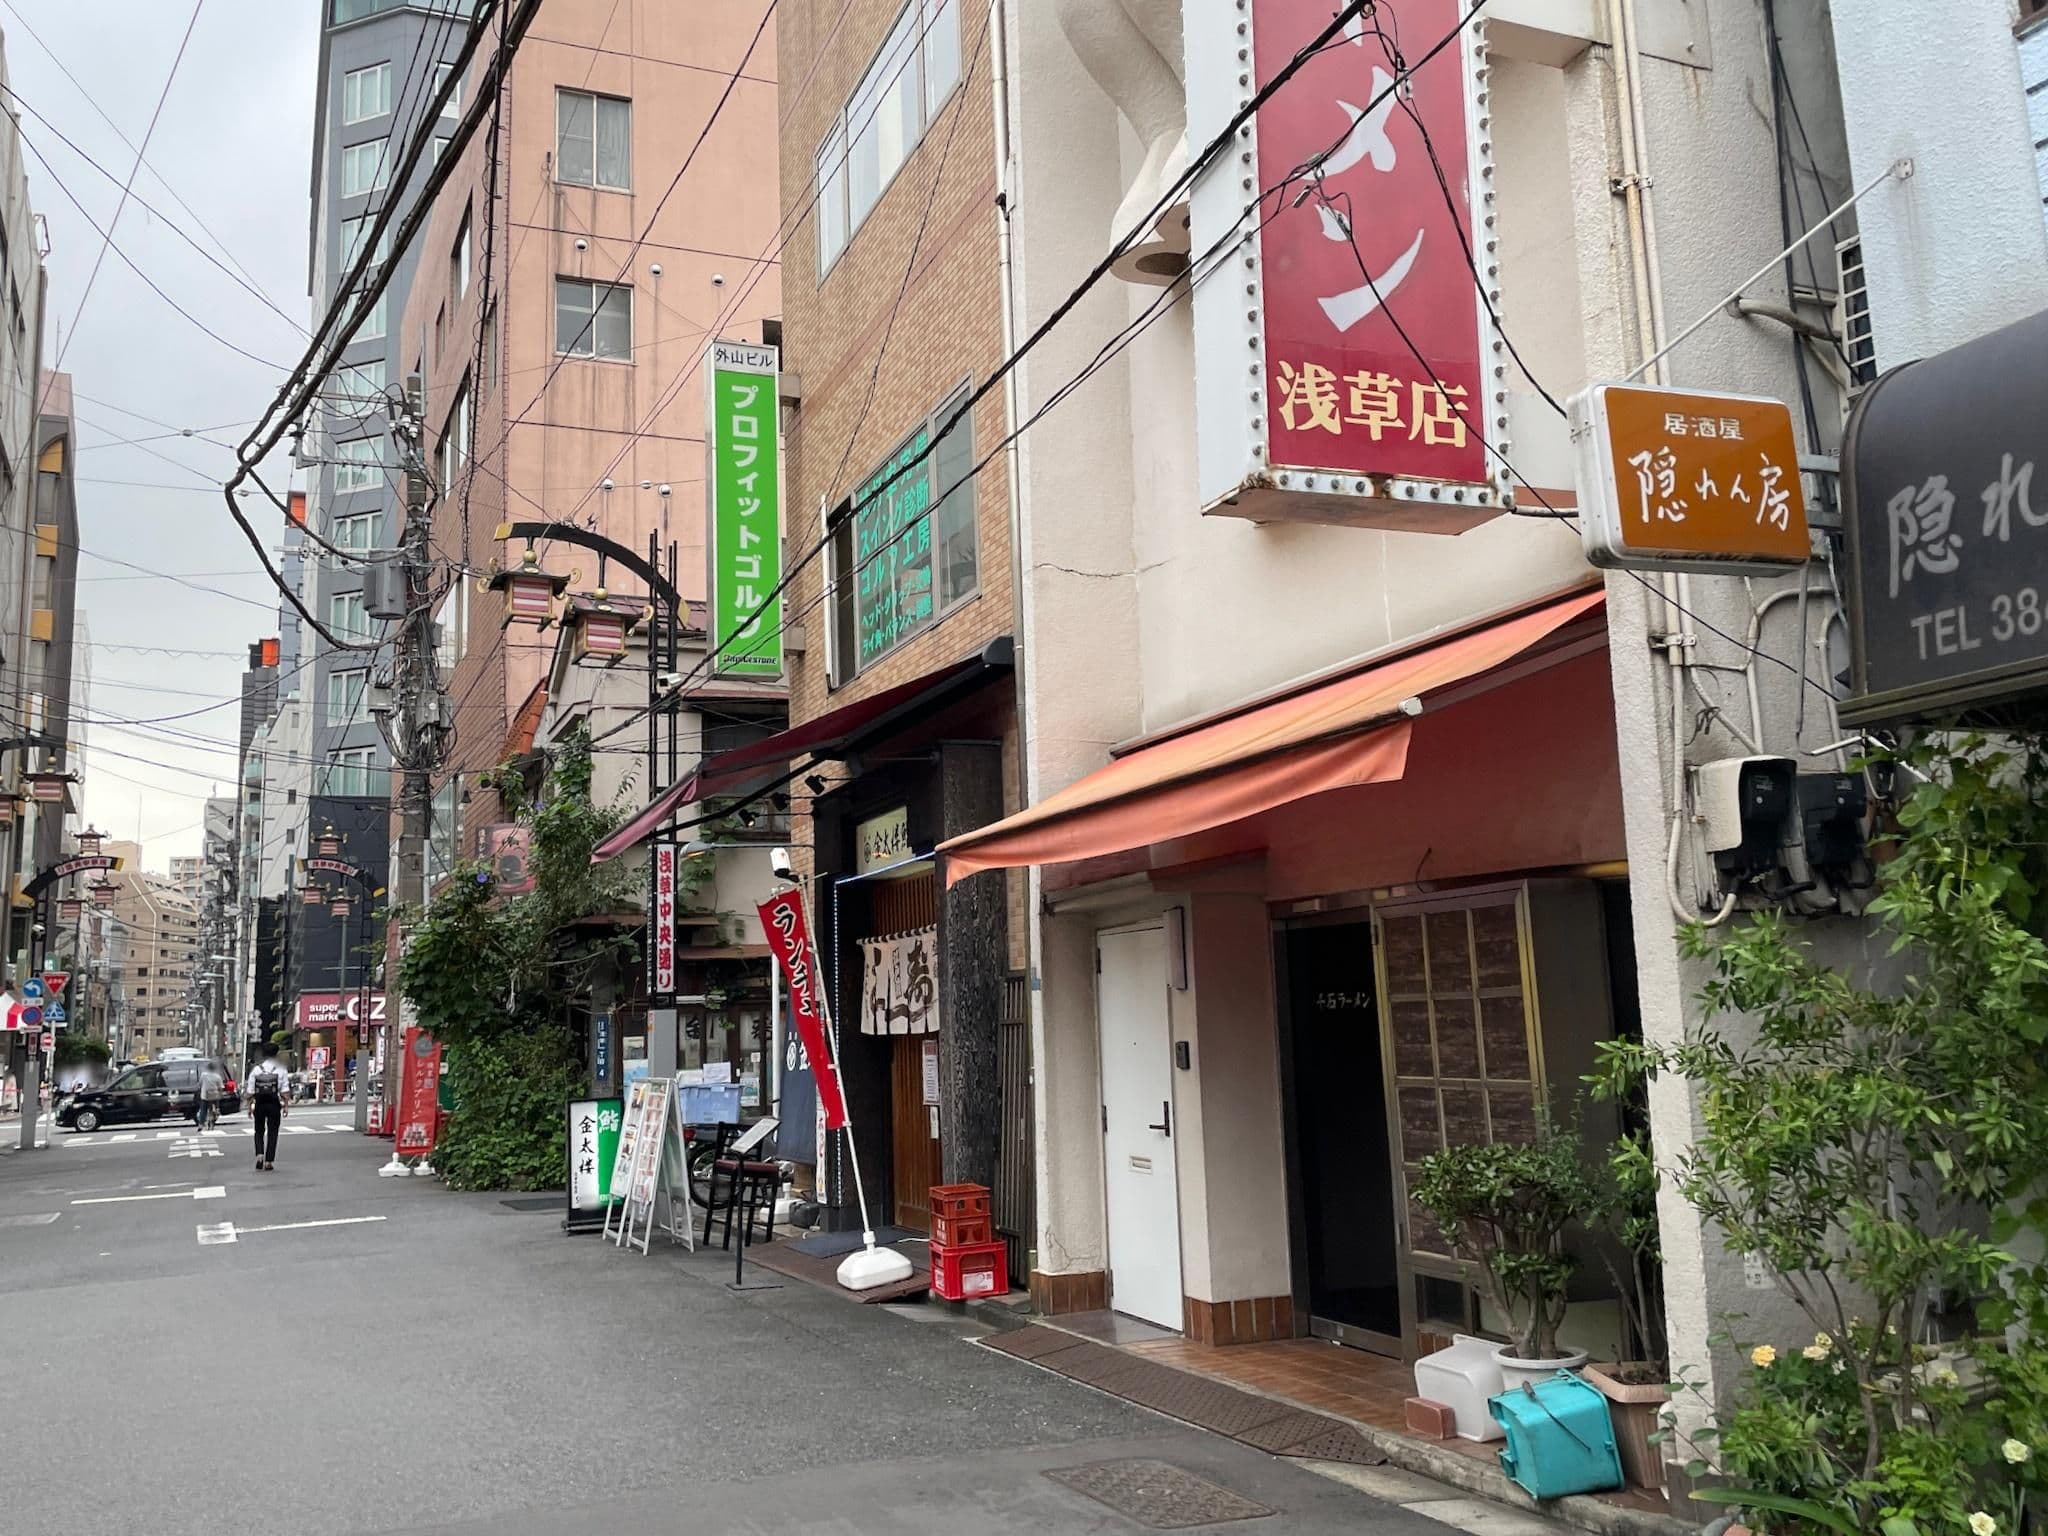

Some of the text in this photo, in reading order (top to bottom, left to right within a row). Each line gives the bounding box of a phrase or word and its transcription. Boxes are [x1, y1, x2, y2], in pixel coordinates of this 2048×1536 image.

[715, 347, 773, 368] 外山ビル
[1276, 360, 1469, 449] 浅草店
[1663, 411, 1745, 441] 居酒屋
[730, 384, 763, 640] プロフィットゴルフ
[1628, 446, 1792, 532] 隠れん房
[1910, 587, 2048, 661] TEL 38
[658, 850, 672, 989] 浅草中央通り
[308, 1003, 339, 1013] super
